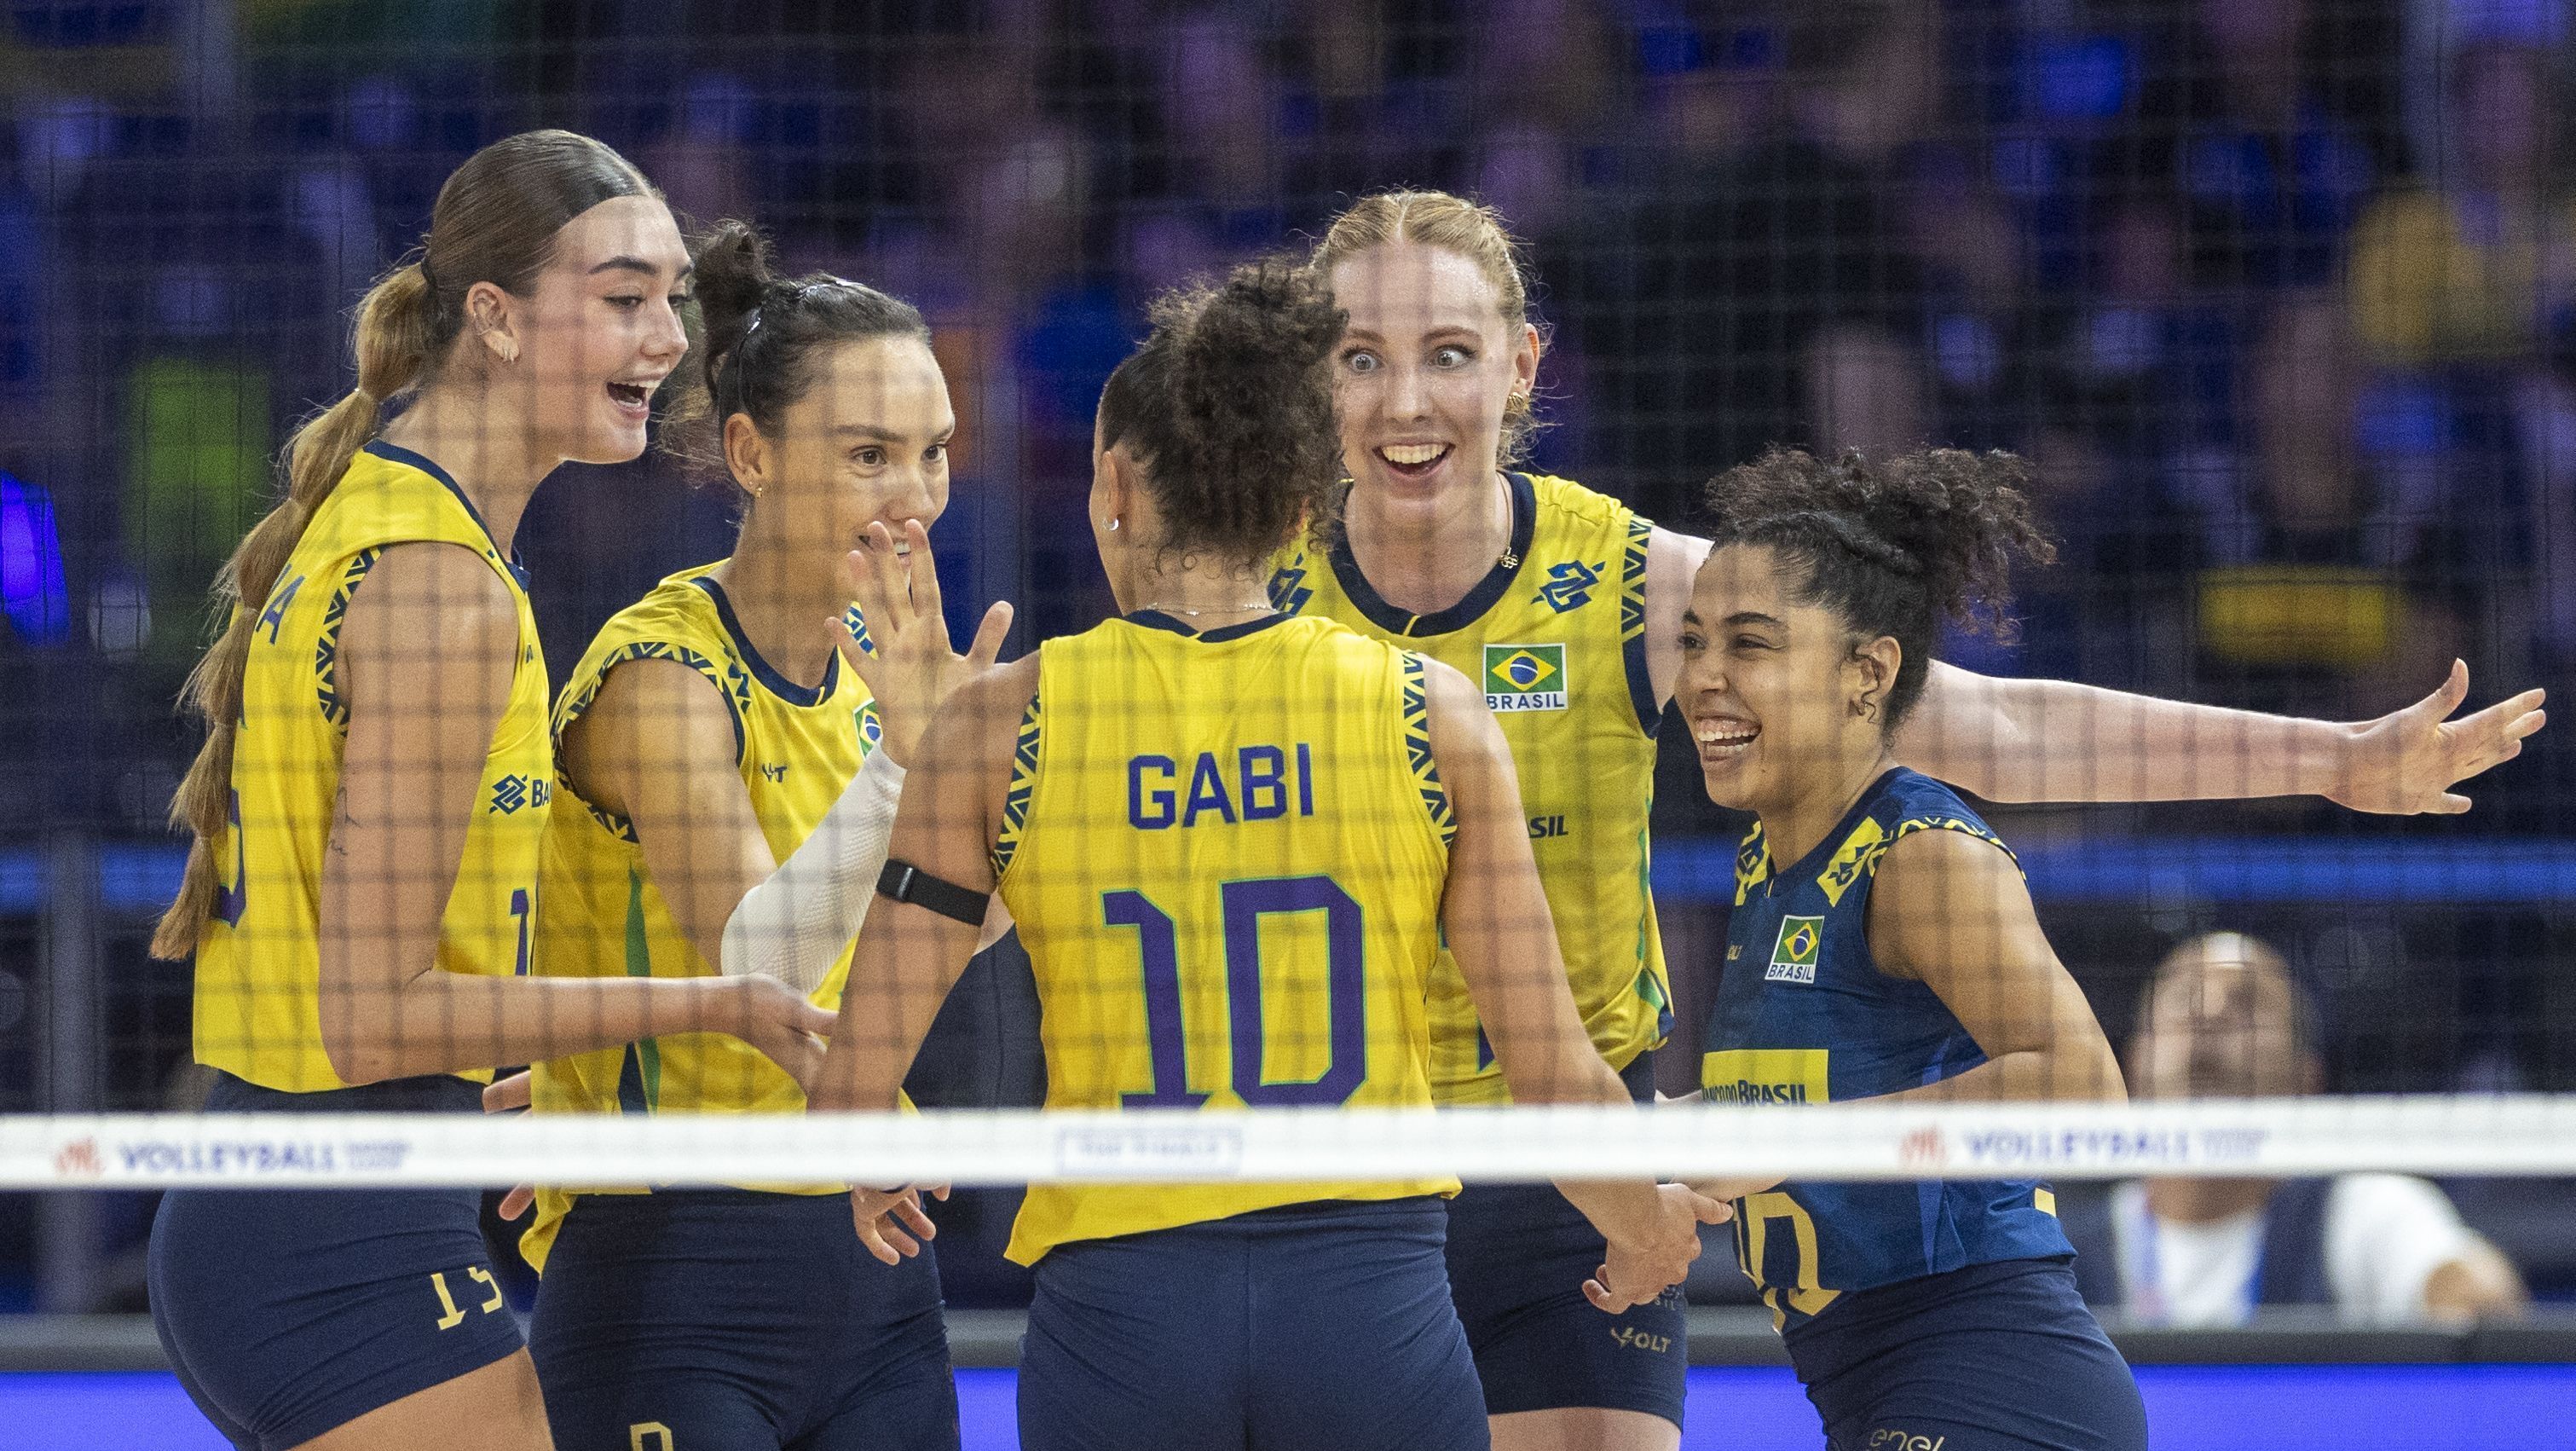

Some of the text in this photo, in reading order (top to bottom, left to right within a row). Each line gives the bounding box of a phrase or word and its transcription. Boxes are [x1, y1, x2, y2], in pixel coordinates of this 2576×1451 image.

[1487, 692, 1565, 710] BRASIL
[1127, 742, 1314, 831] GABI
[1528, 814, 1569, 839] SIL
[1767, 963, 1814, 980] BRASIL
[1100, 874, 1369, 1112] 10
[118, 1139, 335, 1173] VOLLEYBALL
[1965, 1127, 2190, 1160] VOLLEYBALL
[1610, 1327, 1672, 1353] VOLT
[1869, 1428, 1945, 1451] enel
